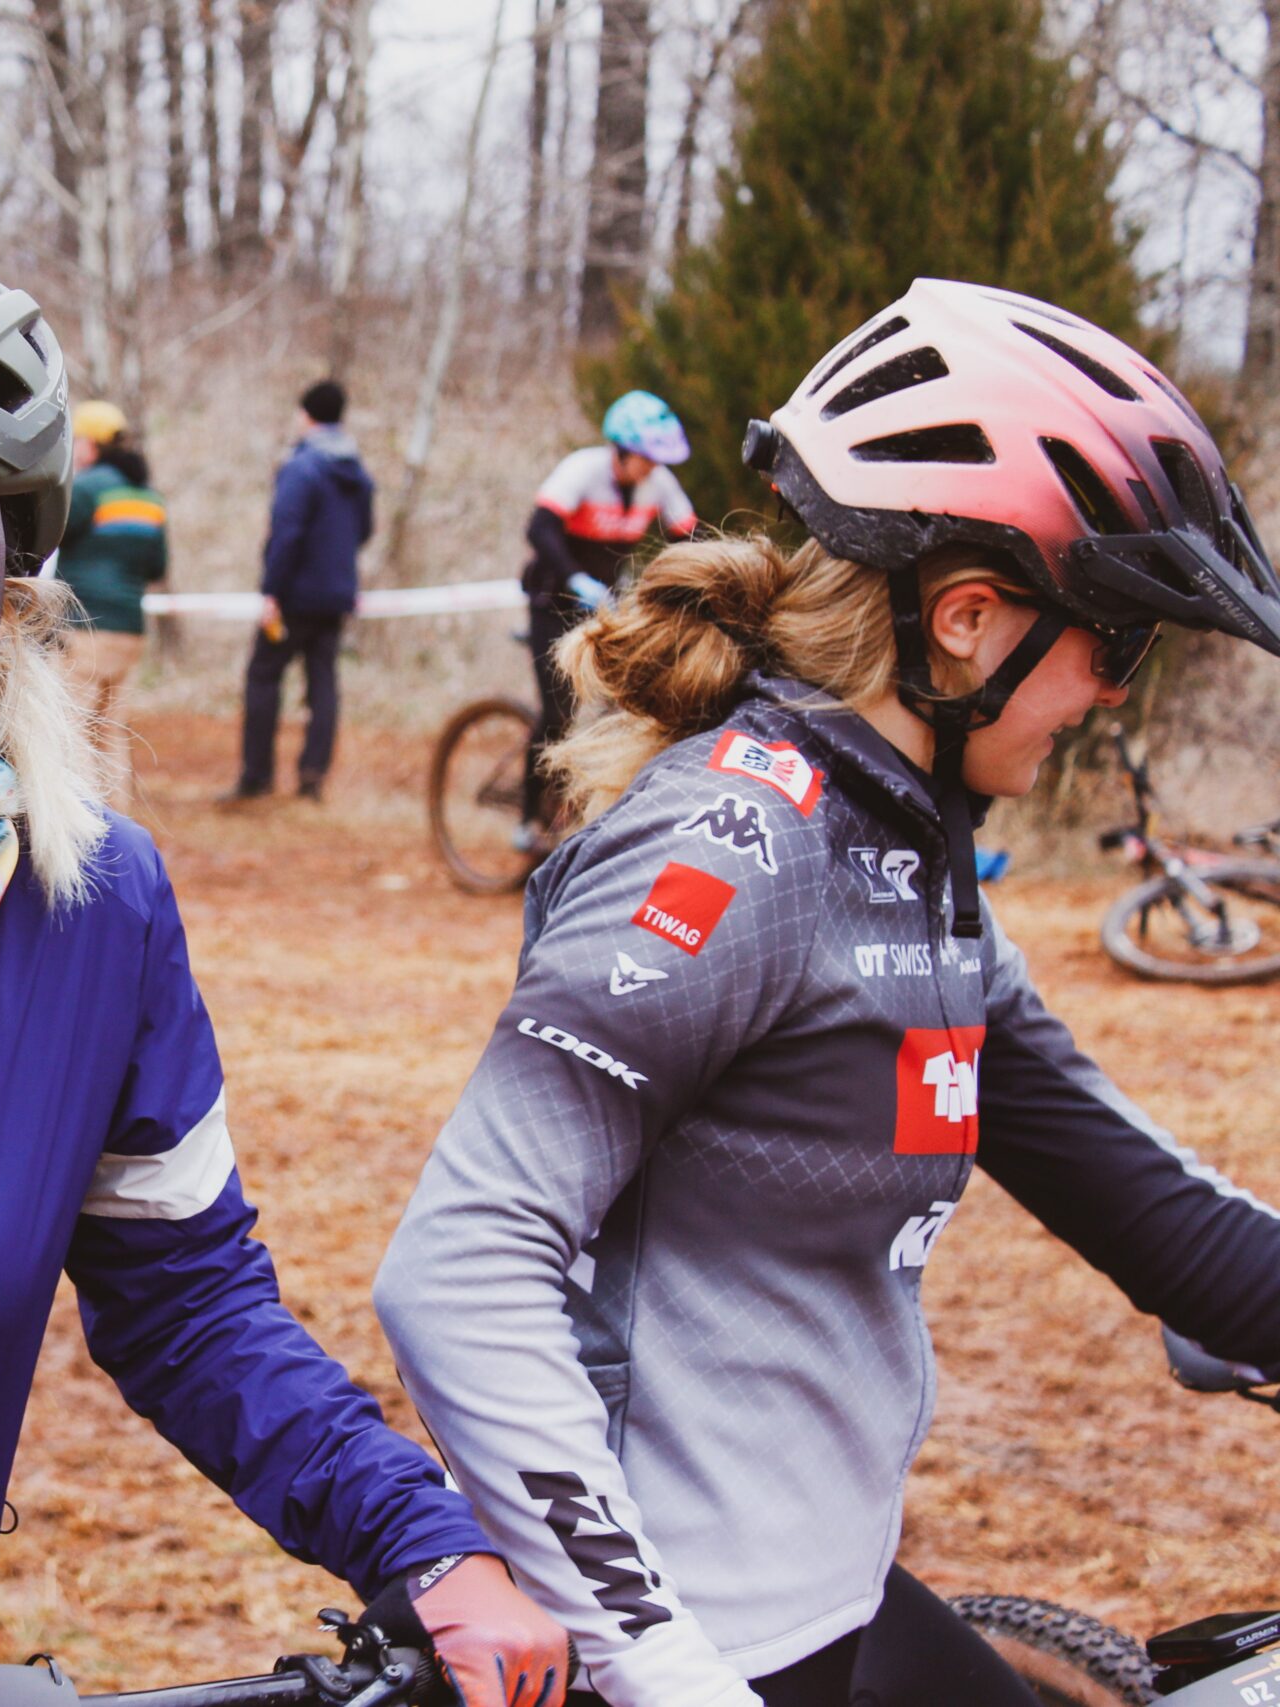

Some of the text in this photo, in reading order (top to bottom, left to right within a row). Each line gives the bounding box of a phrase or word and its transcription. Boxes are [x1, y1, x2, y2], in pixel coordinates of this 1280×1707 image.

[643, 904, 701, 946] TIWAG
[855, 944, 932, 977] DT SWISS
[516, 1017, 650, 1090] LOOK
[517, 1470, 673, 1640] KTM
[1235, 1625, 1278, 1647] GARMIN
[1240, 1681, 1276, 1706] OZ
